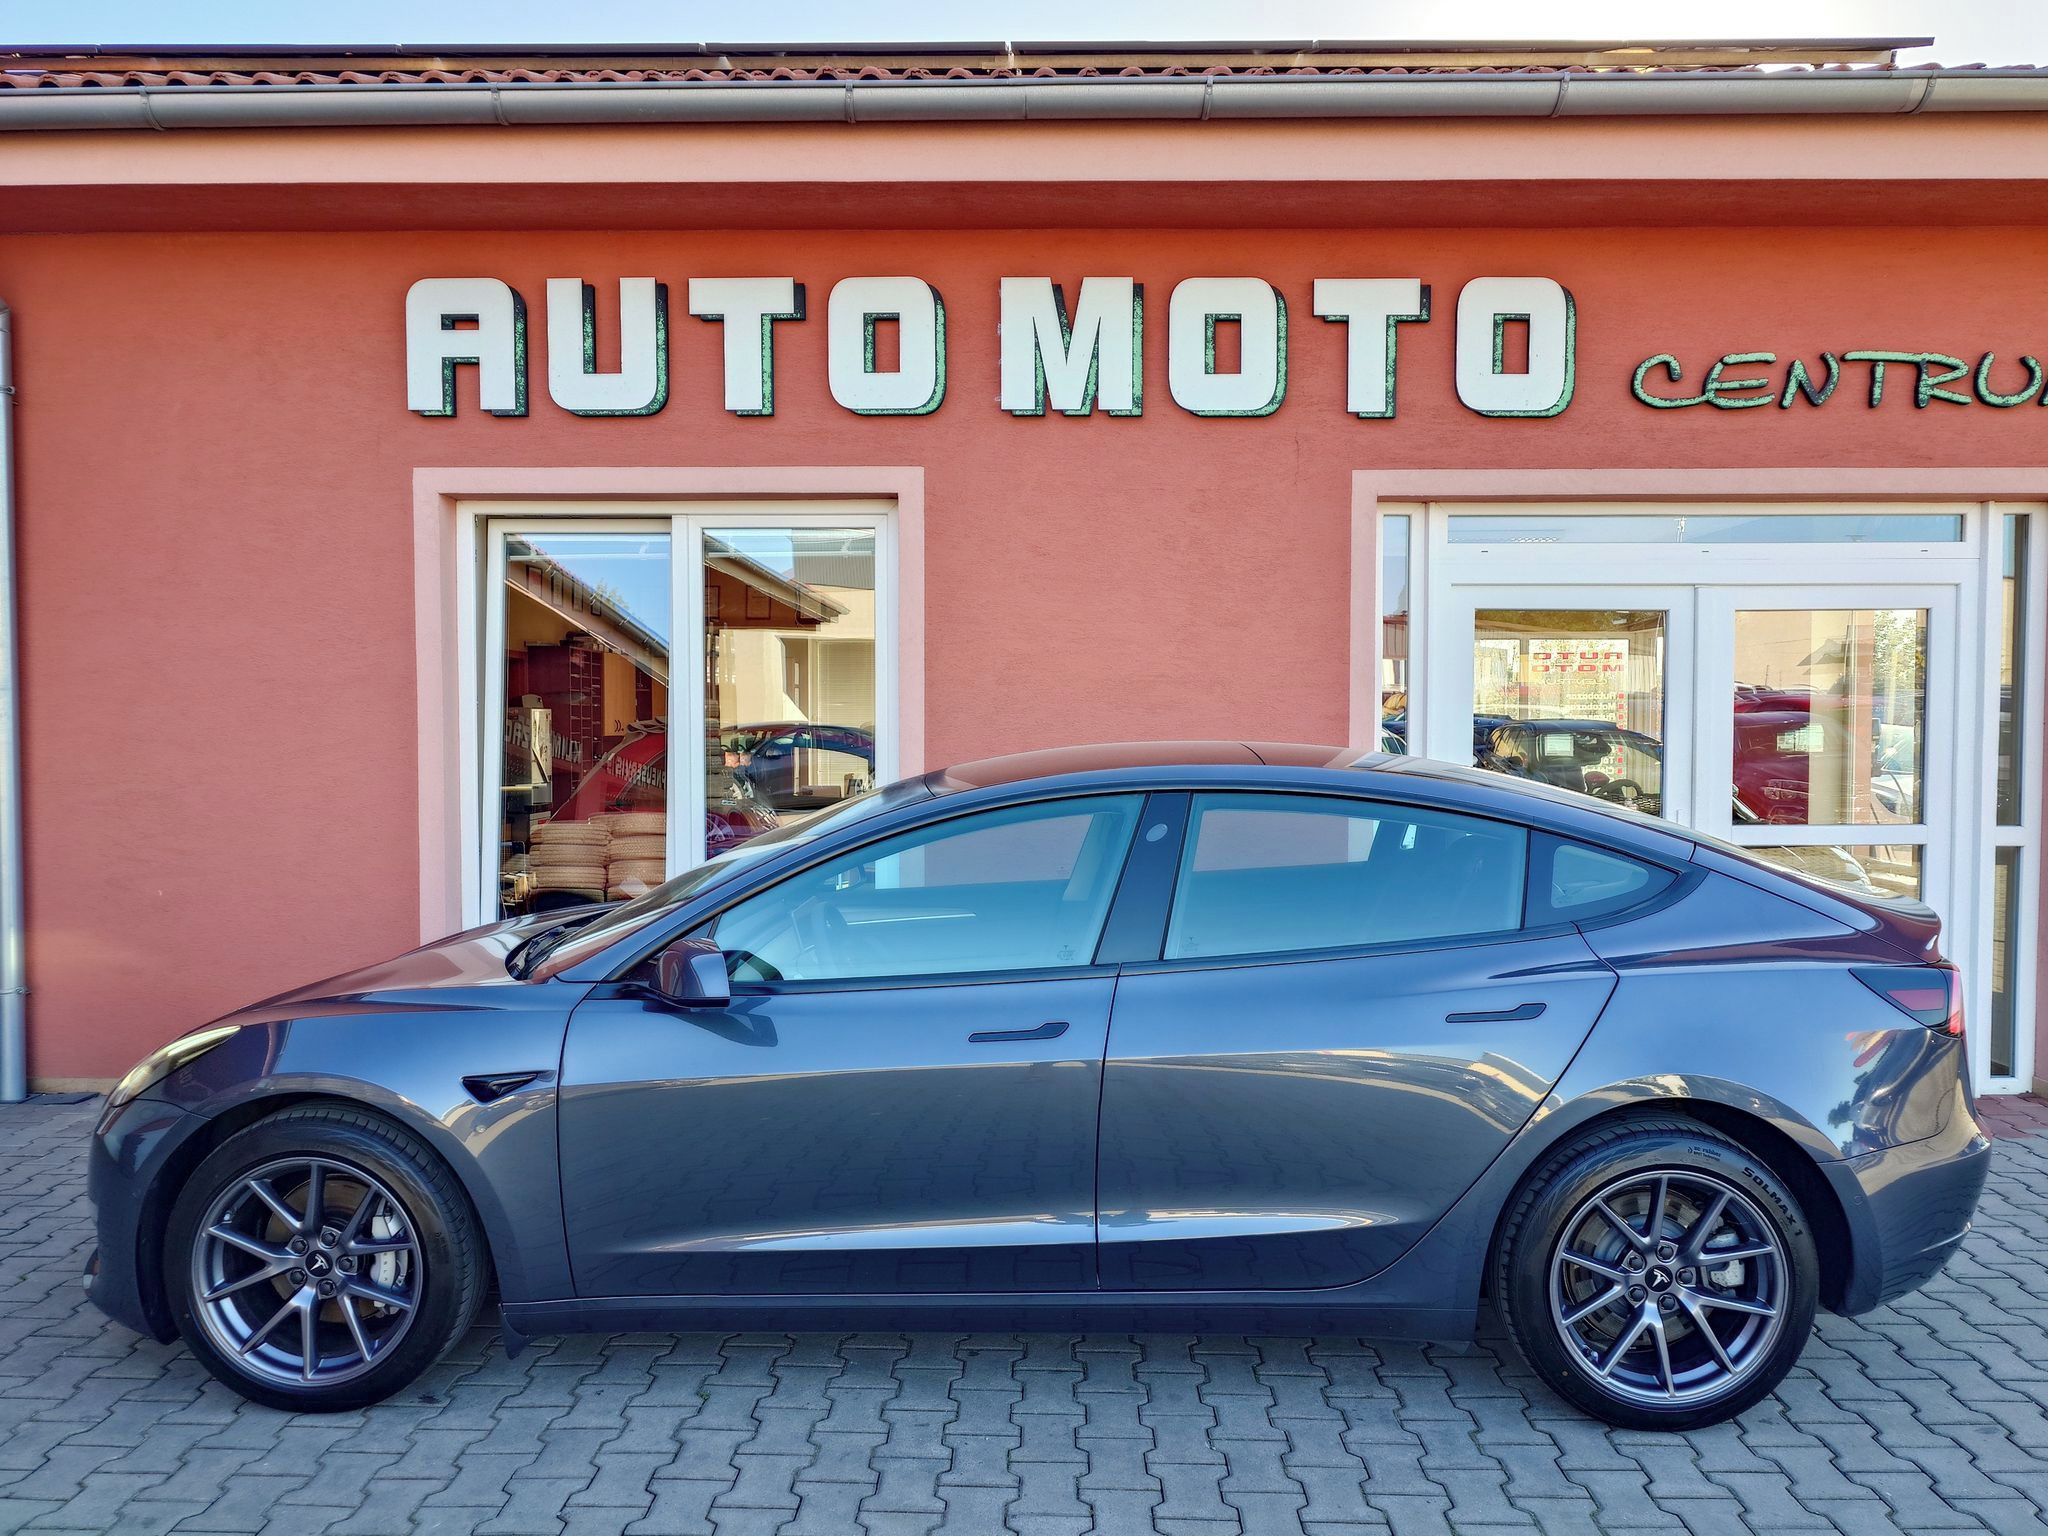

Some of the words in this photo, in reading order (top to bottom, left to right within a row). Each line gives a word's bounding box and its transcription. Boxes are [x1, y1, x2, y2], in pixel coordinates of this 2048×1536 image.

[405, 276, 947, 416] AUTO
[1000, 276, 1576, 417] MOTO
[1631, 351, 2048, 409] CENTRU
[1741, 1166, 1797, 1226] SOLMAX
